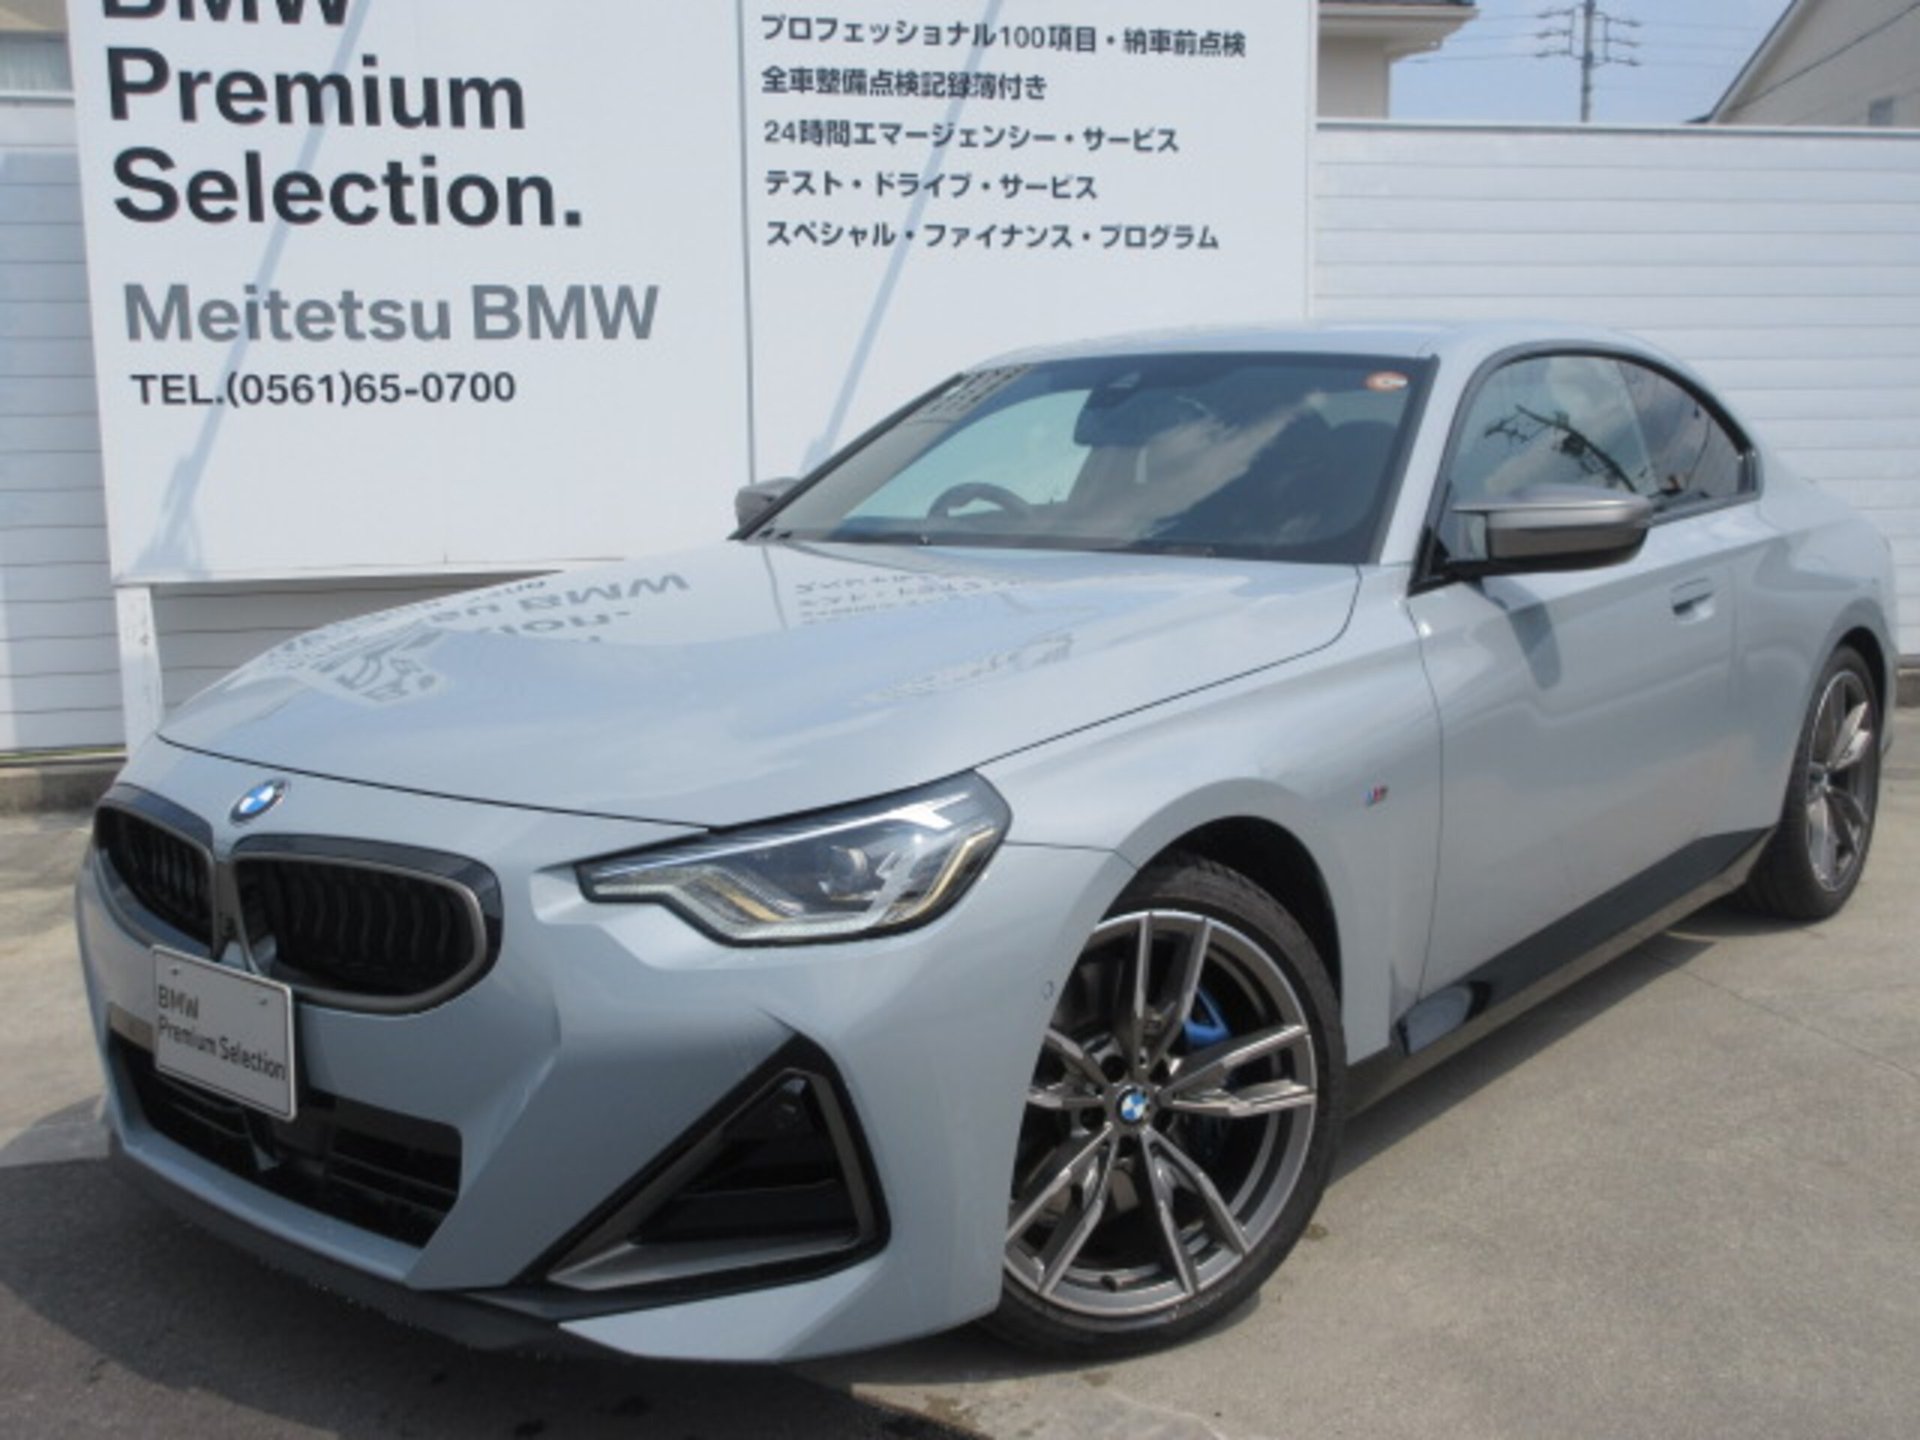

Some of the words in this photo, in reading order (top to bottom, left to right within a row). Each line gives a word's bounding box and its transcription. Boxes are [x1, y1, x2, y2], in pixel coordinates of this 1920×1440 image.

[106, 46, 525, 130] Premium
[764, 119, 1179, 153] 24時間エマージェンシー・サービス
[113, 146, 582, 228] Selection.
[124, 283, 451, 342] Meitetsu
[472, 284, 659, 340] BMW
[129, 369, 516, 409] TEL.(0561)65-0700
[159, 986, 198, 1019] BMW
[159, 1016, 217, 1055] Premium
[219, 1036, 285, 1080] Selection
